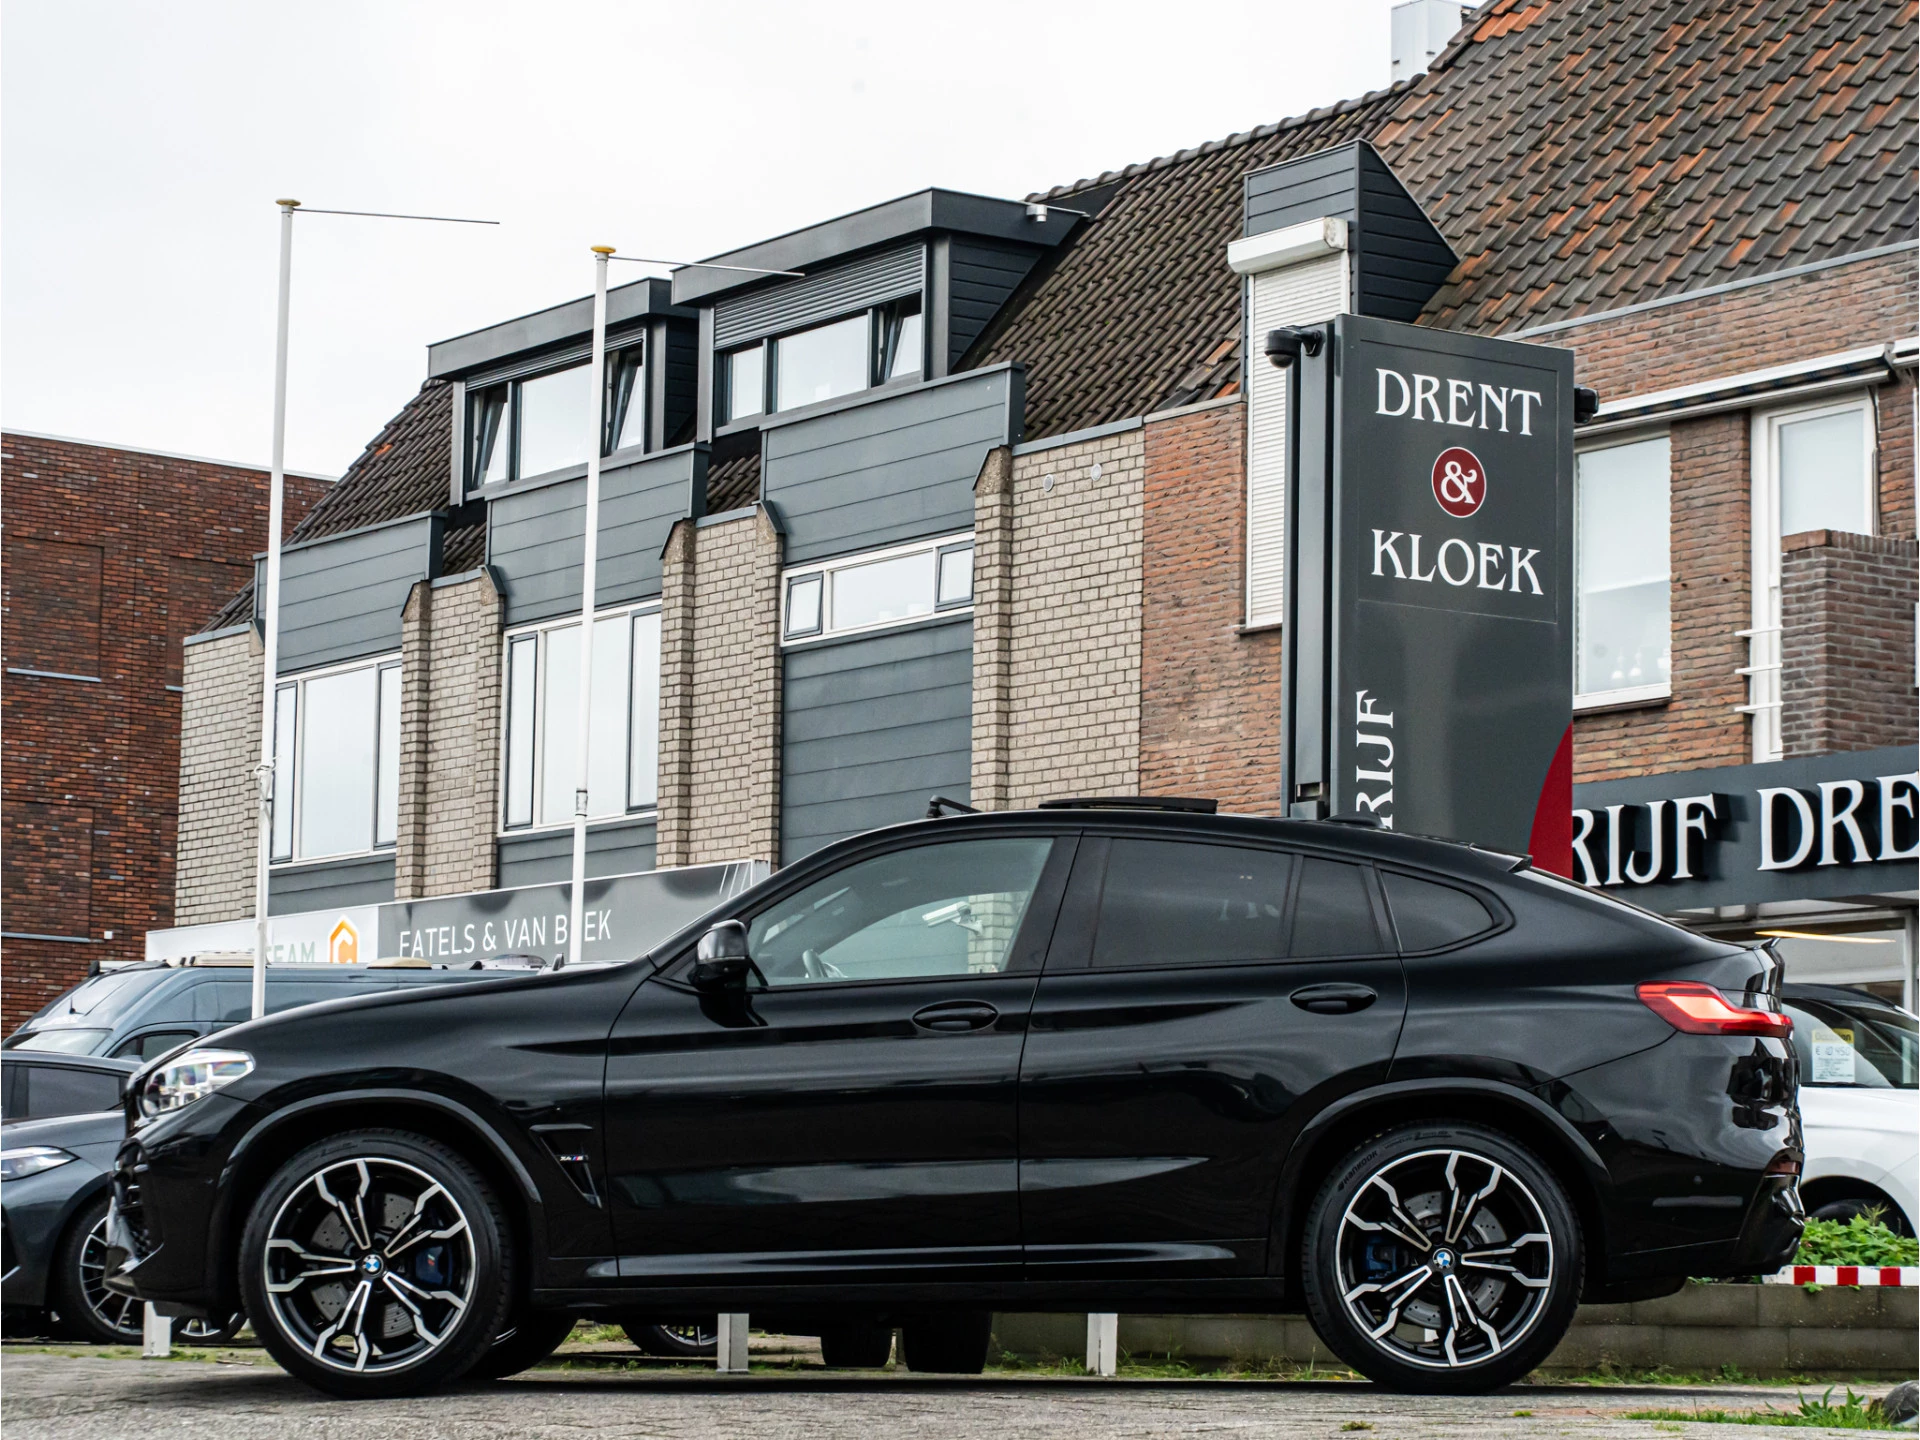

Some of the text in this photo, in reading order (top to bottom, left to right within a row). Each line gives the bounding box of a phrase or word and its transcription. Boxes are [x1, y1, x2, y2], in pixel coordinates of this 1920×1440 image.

[1375, 367, 1543, 437] DRENT
[1440, 460, 1478, 505] &
[1370, 528, 1545, 596] KLOEK
[1755, 770, 1919, 872] DRE
[482, 921, 497, 952] &
[504, 915, 547, 950] VAN
[554, 908, 612, 946] BEK
